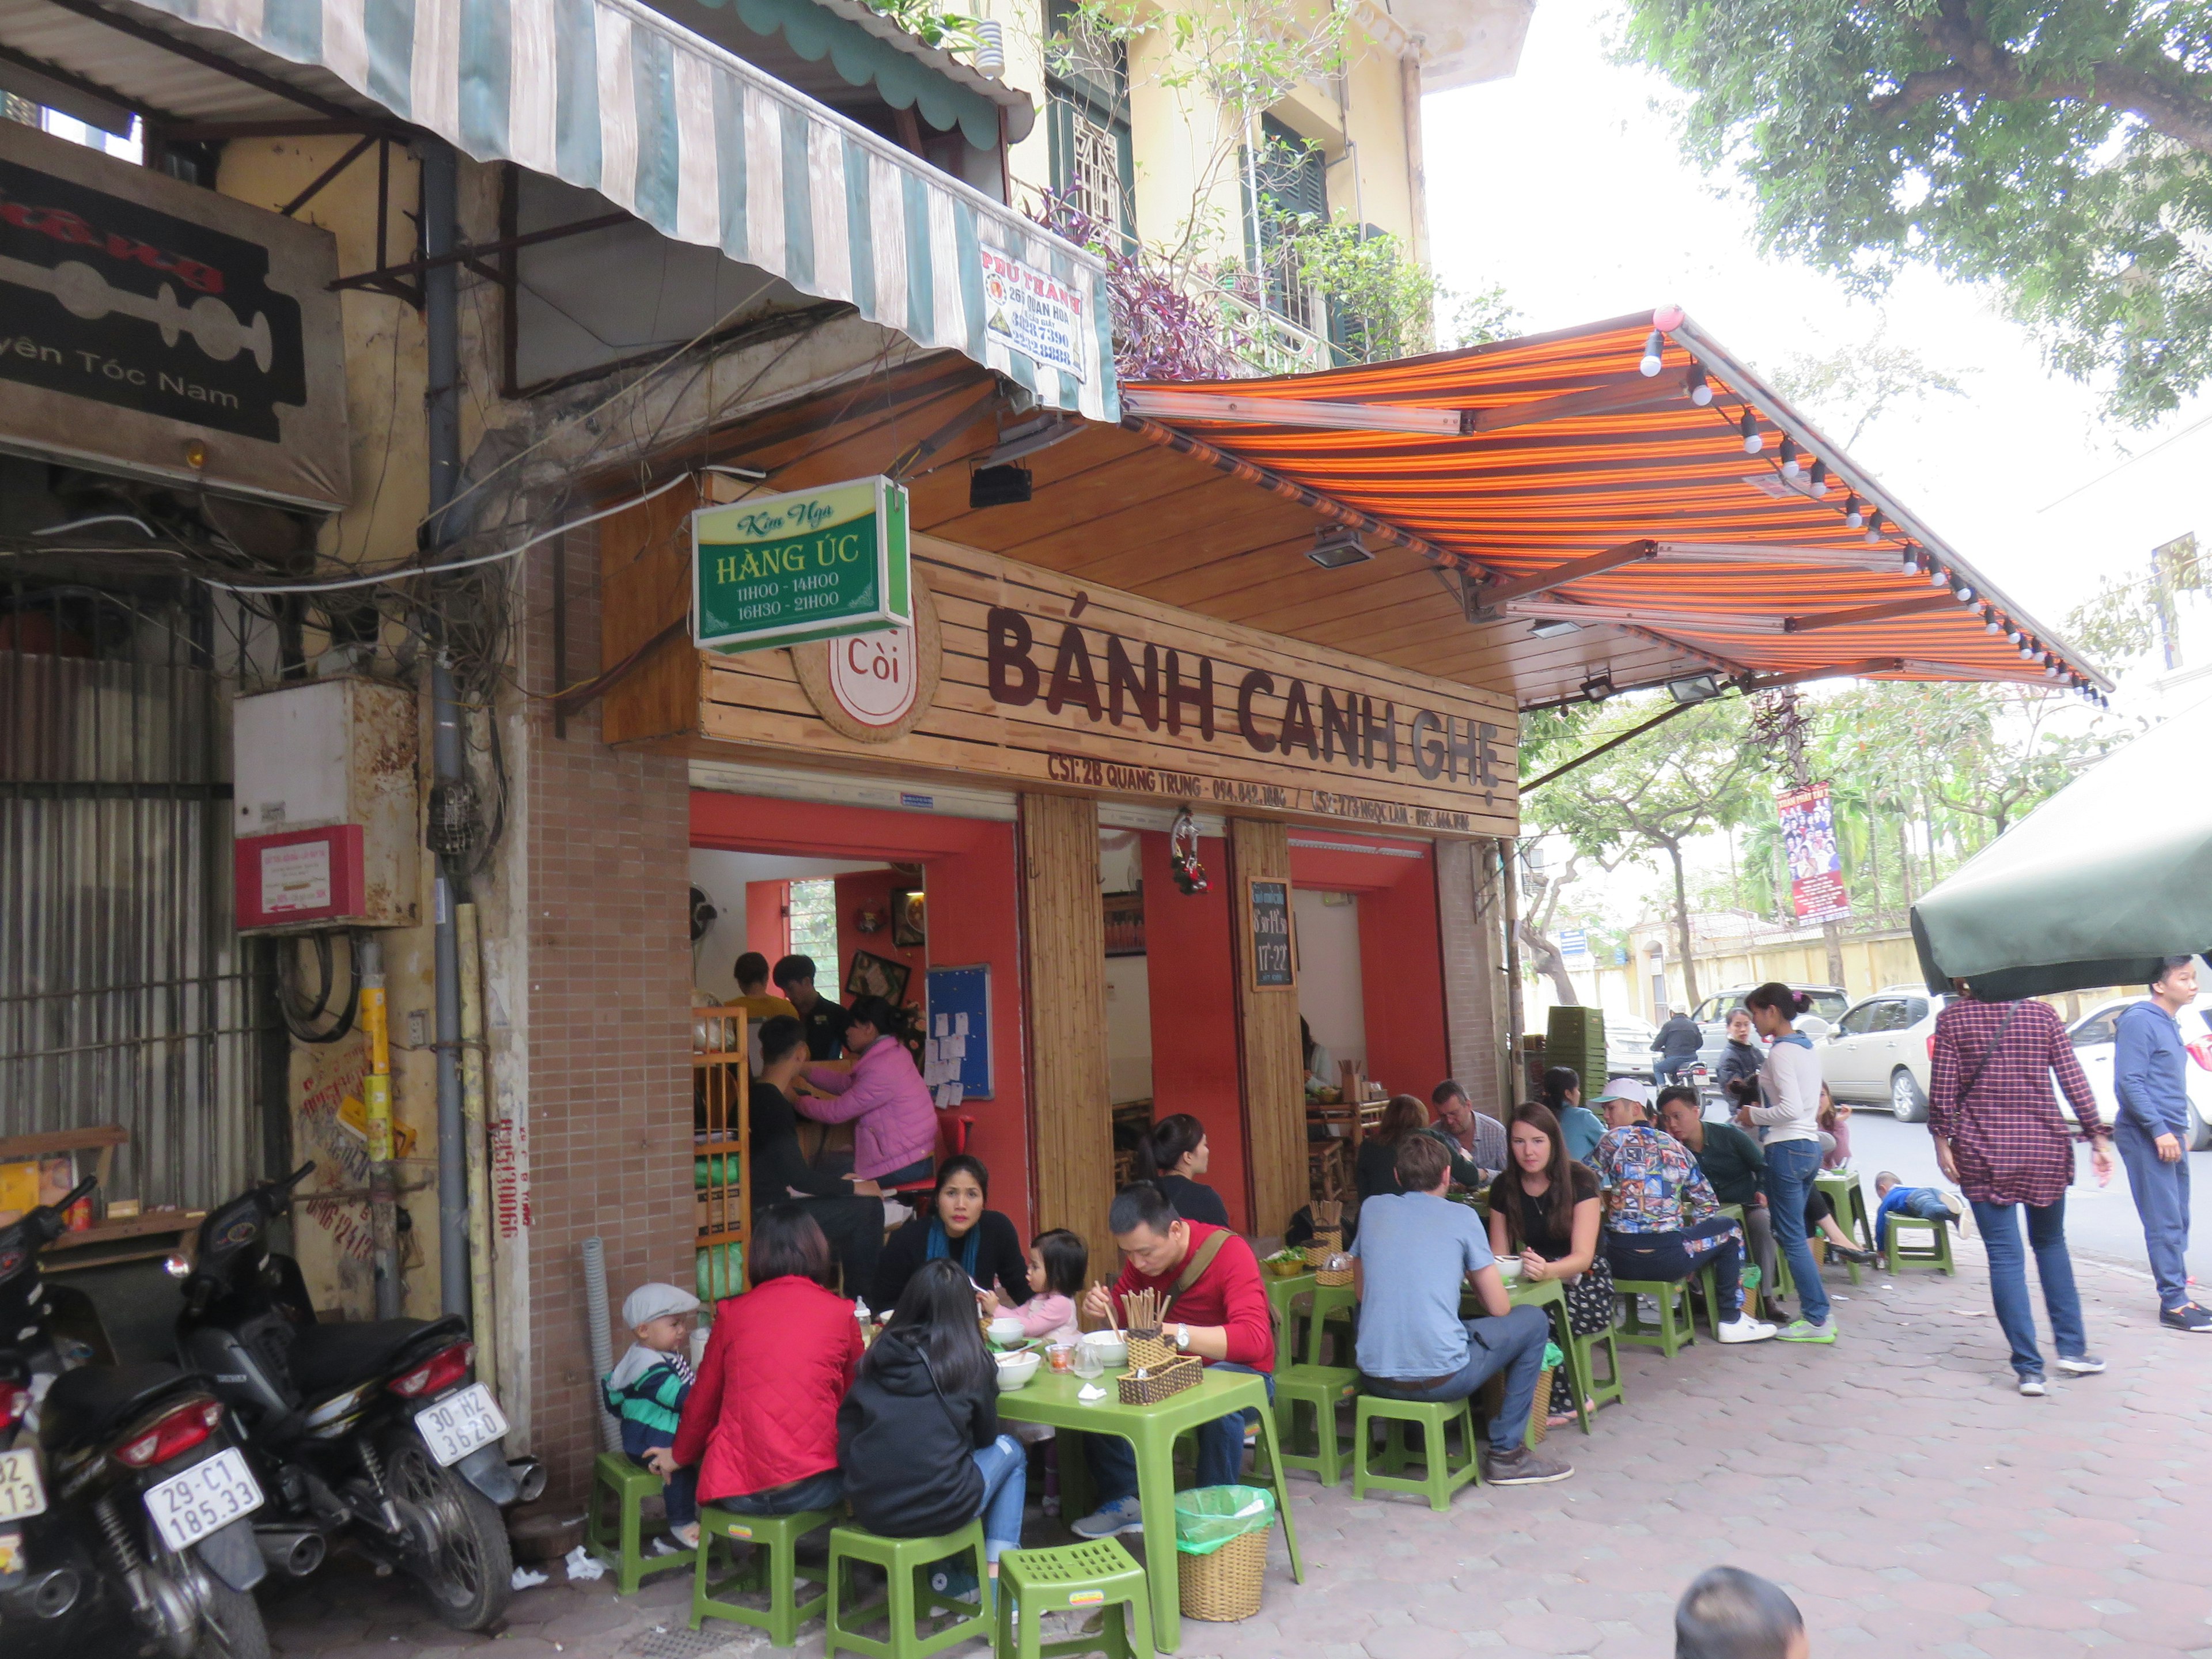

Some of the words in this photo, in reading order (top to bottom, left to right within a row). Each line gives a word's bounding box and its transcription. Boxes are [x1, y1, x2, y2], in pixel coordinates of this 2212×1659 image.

[1027, 294, 1050, 317] QUAN
[1053, 305, 1070, 325] HOA
[75, 349, 146, 386] Tóc
[158, 372, 239, 409] Nam
[737, 511, 785, 537] Kim
[786, 499, 834, 529] Nga
[716, 543, 806, 585] HÀNG
[816, 533, 859, 567] ÚC
[737, 582, 779, 602] 11H00
[792, 571, 839, 593] 14H00
[794, 591, 839, 612] 21H00
[848, 637, 899, 684] Còi
[987, 591, 1214, 742] BÁNH
[1238, 669, 1397, 773] CANH
[1412, 709, 1498, 807] GHẸ
[1082, 758, 1103, 786] 2B
[1106, 764, 1156, 792] QUANG
[1158, 772, 1202, 797] TRUNG
[442, 1413, 497, 1456] 3620
[162, 1459, 236, 1514] 29-C1
[170, 1481, 255, 1541] 185.33
